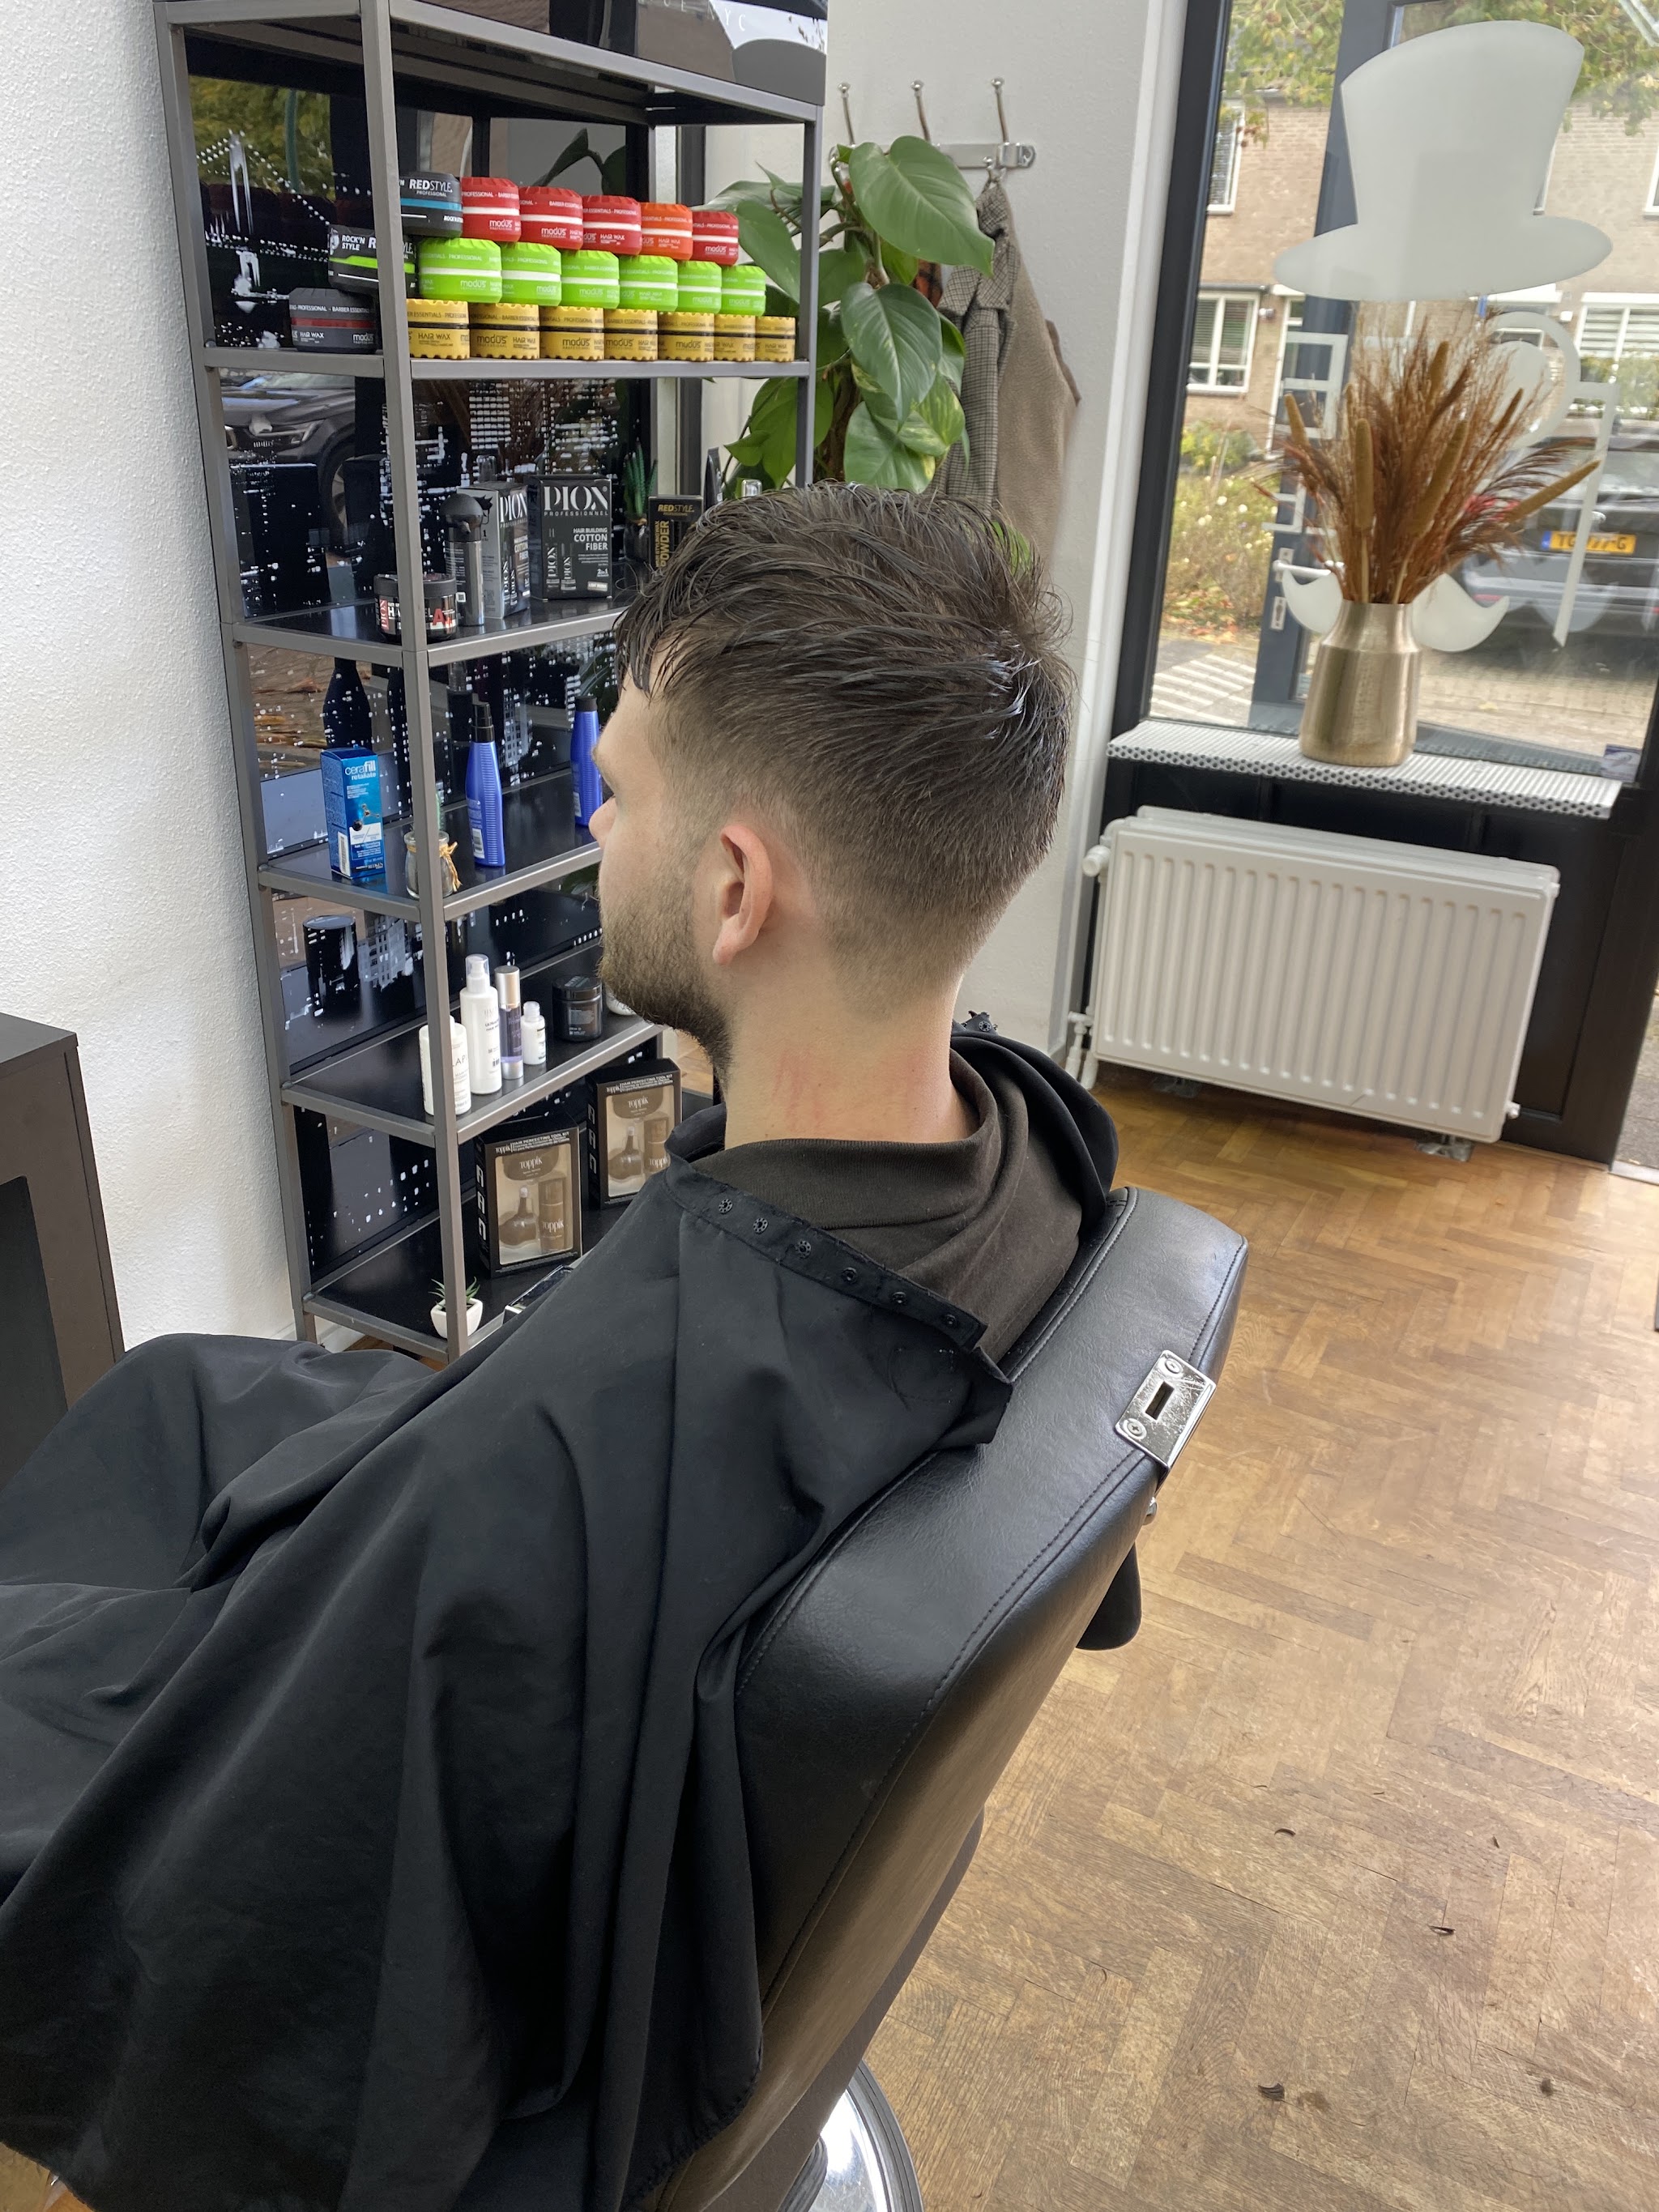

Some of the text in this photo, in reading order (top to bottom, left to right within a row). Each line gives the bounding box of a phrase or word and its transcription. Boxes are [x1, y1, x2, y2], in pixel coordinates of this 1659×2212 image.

[416, 190, 447, 198] PROFESSIONAL
[341, 234, 366, 245] ROCK'N
[341, 242, 361, 251] STYLE
[418, 332, 450, 340] HAIR WAX
[476, 335, 509, 344] modus
[562, 337, 591, 347] modus
[606, 338, 634, 347] modus
[574, 533, 608, 543] COTTON
[586, 542, 608, 551] FIBER
[659, 520, 670, 568] POWDER
[344, 760, 377, 776] cerafill
[351, 772, 377, 781] retaliate
[522, 1136, 551, 1144] PERFECTING
